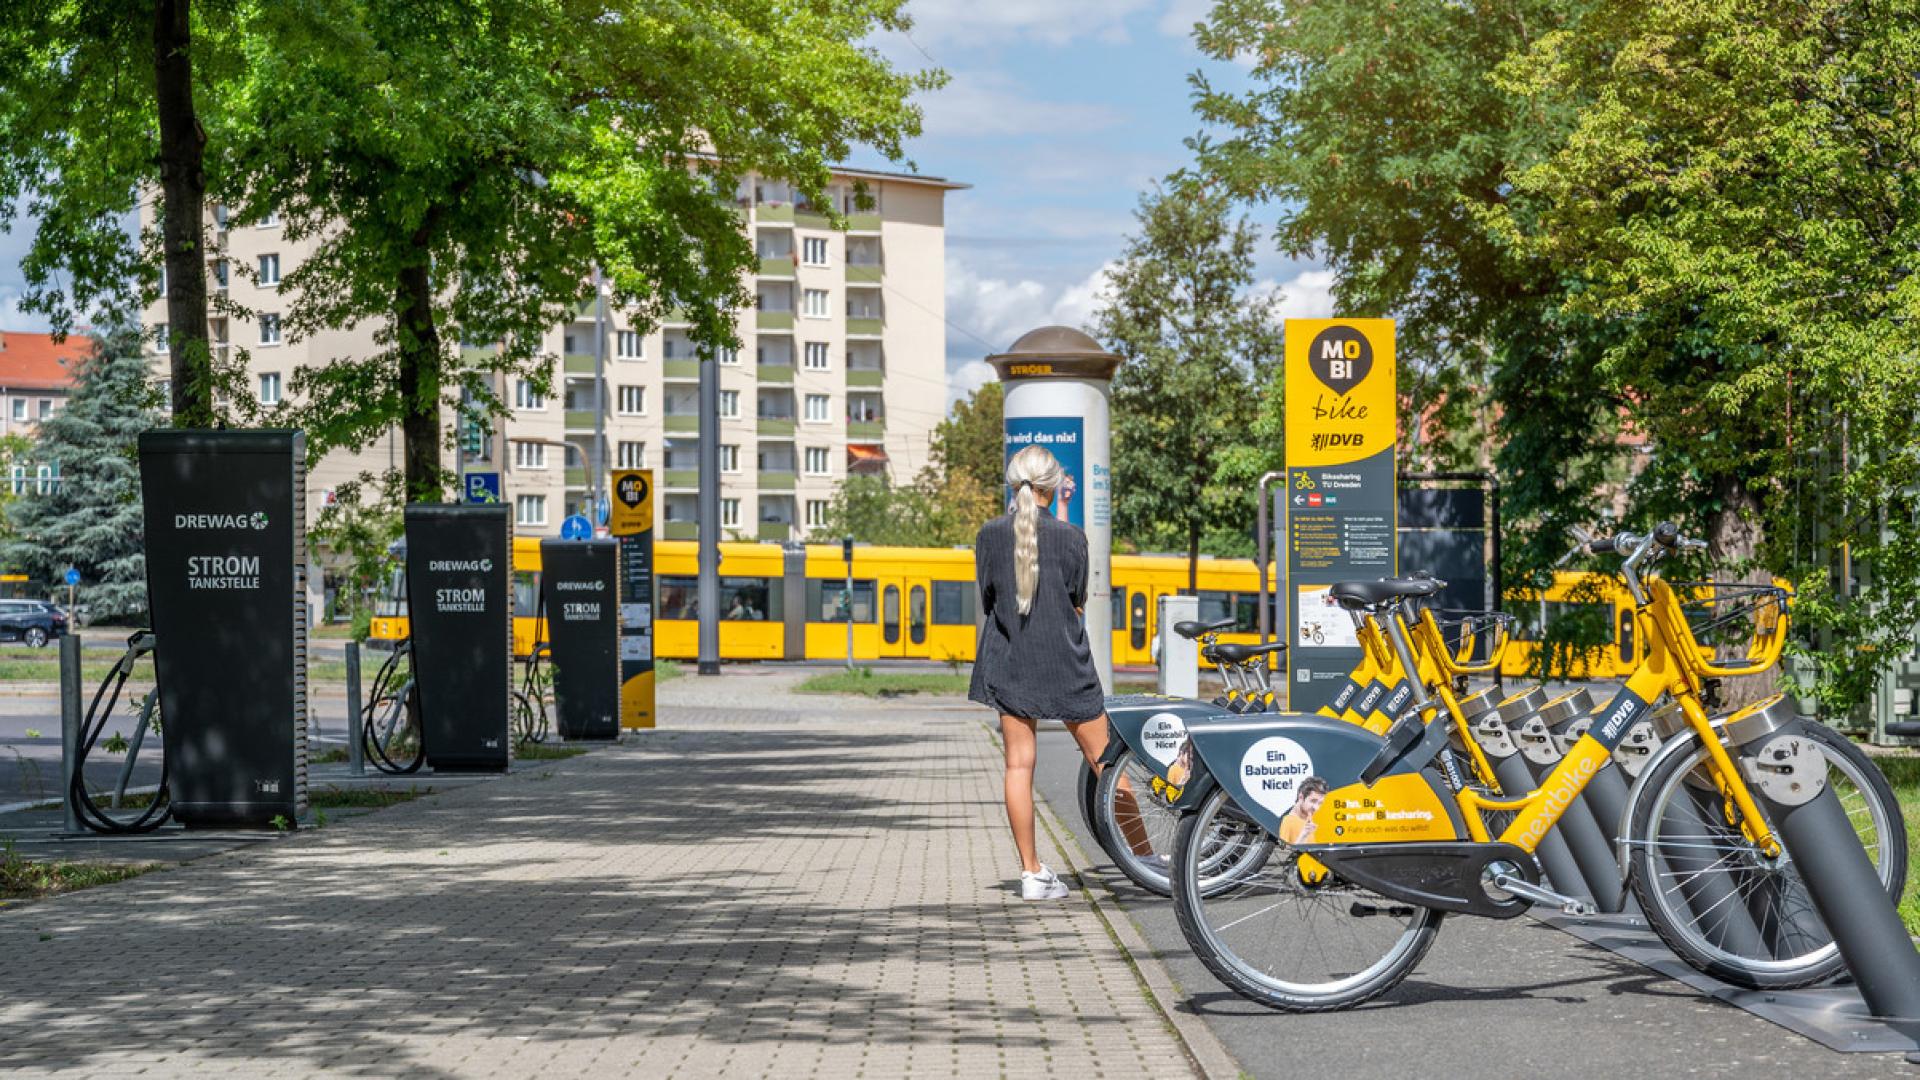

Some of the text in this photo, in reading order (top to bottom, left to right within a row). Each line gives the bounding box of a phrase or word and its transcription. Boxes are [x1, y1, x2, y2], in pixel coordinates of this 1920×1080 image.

[1321, 339, 1361, 359] MO
[1329, 360, 1353, 379] BI
[1312, 393, 1368, 421] bike
[1013, 431, 1033, 444] wird
[1034, 431, 1054, 444] das
[1055, 431, 1077, 444] nix!
[1329, 433, 1364, 447] DVB
[1322, 472, 1361, 482] Bikesharing
[1333, 481, 1362, 489] Dresden
[175, 514, 249, 529] DREWAG
[188, 555, 260, 576] STROM
[429, 560, 479, 572] DREWAG
[188, 577, 260, 589] TANKSTELLE
[436, 589, 485, 603] STROM
[437, 603, 485, 612] TANKSTELLE
[563, 602, 600, 613] STROM
[1158, 721, 1172, 730] Ein
[1144, 730, 1187, 739] Babucabi?
[1155, 740, 1177, 749] Nice!
[1266, 751, 1287, 762] Ein
[1245, 763, 1309, 776] Babucabi?
[1262, 778, 1293, 791] Nice!
[1518, 757, 1597, 849] nextbike
